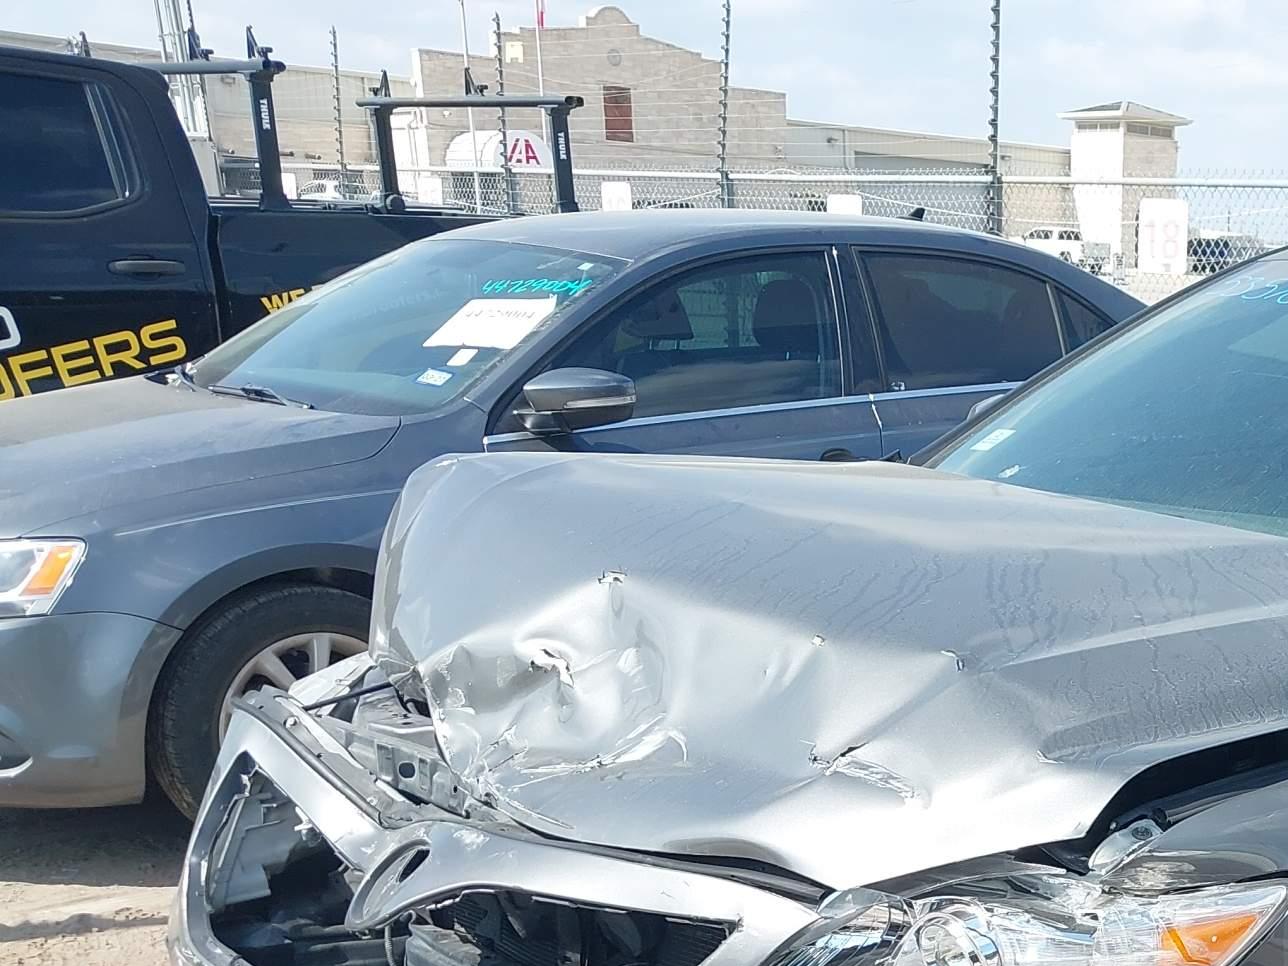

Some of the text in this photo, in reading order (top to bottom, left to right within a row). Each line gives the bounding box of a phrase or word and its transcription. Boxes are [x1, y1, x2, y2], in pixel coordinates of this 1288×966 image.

[259, 97, 271, 130] THULE
[557, 131, 568, 160] THULE
[482, 279, 592, 295] 44729004
